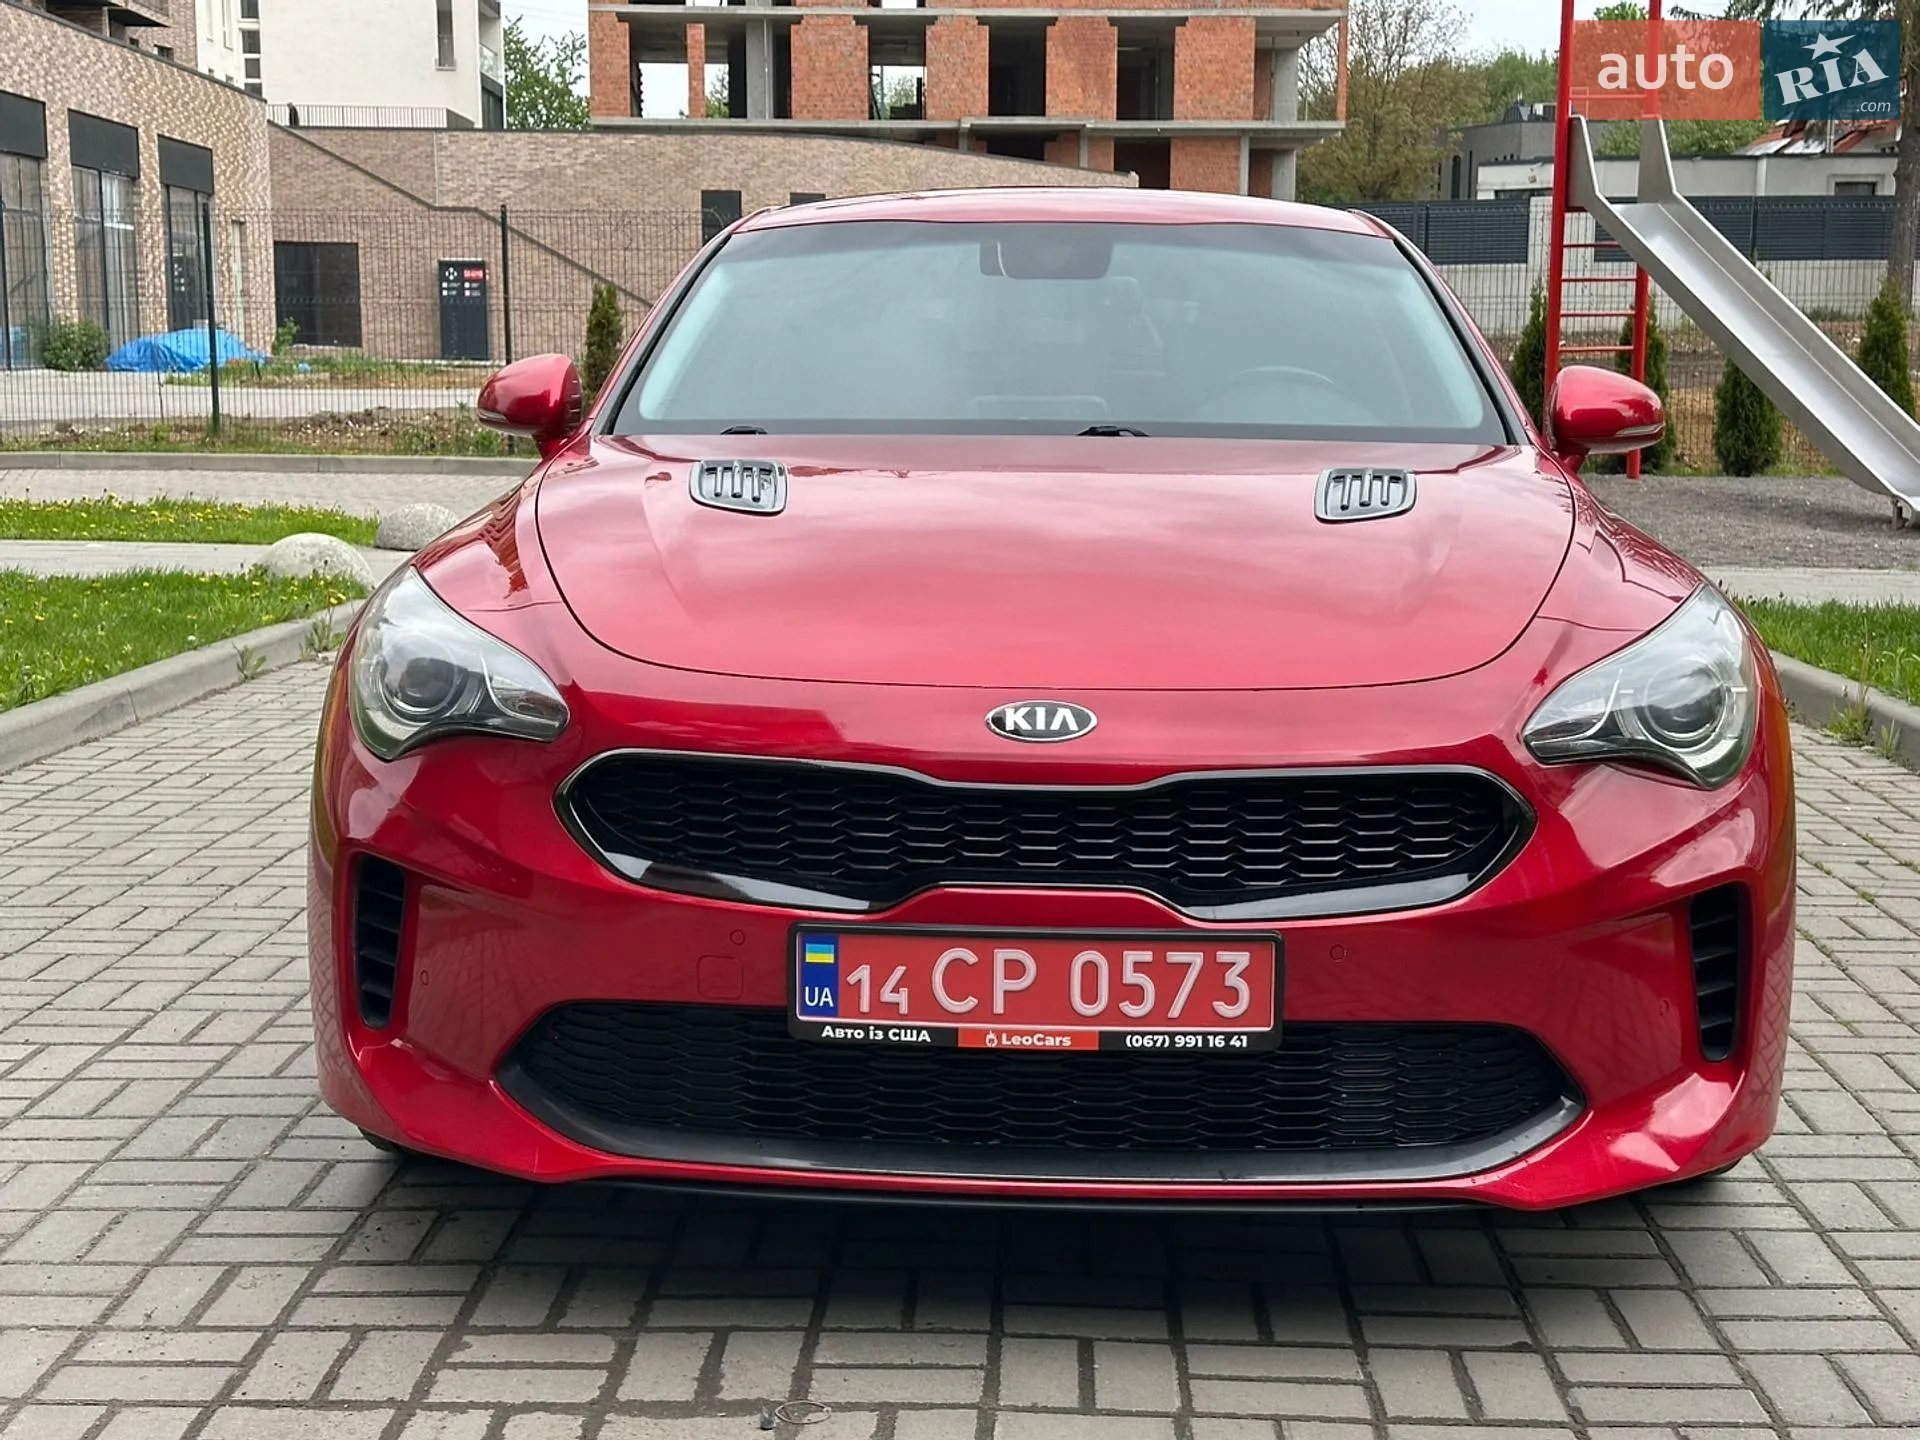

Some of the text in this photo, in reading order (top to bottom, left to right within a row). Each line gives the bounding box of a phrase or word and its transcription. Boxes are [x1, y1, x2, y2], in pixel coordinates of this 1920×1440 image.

[1004, 706, 1079, 731] KIA
[846, 947, 1252, 1020] 14 CP 0573
[804, 987, 835, 1008] UA
[821, 1025, 932, 1043] Авто із США
[1001, 1033, 1072, 1048] LeoCars
[1125, 1034, 1248, 1048] (067) 991 16 41
